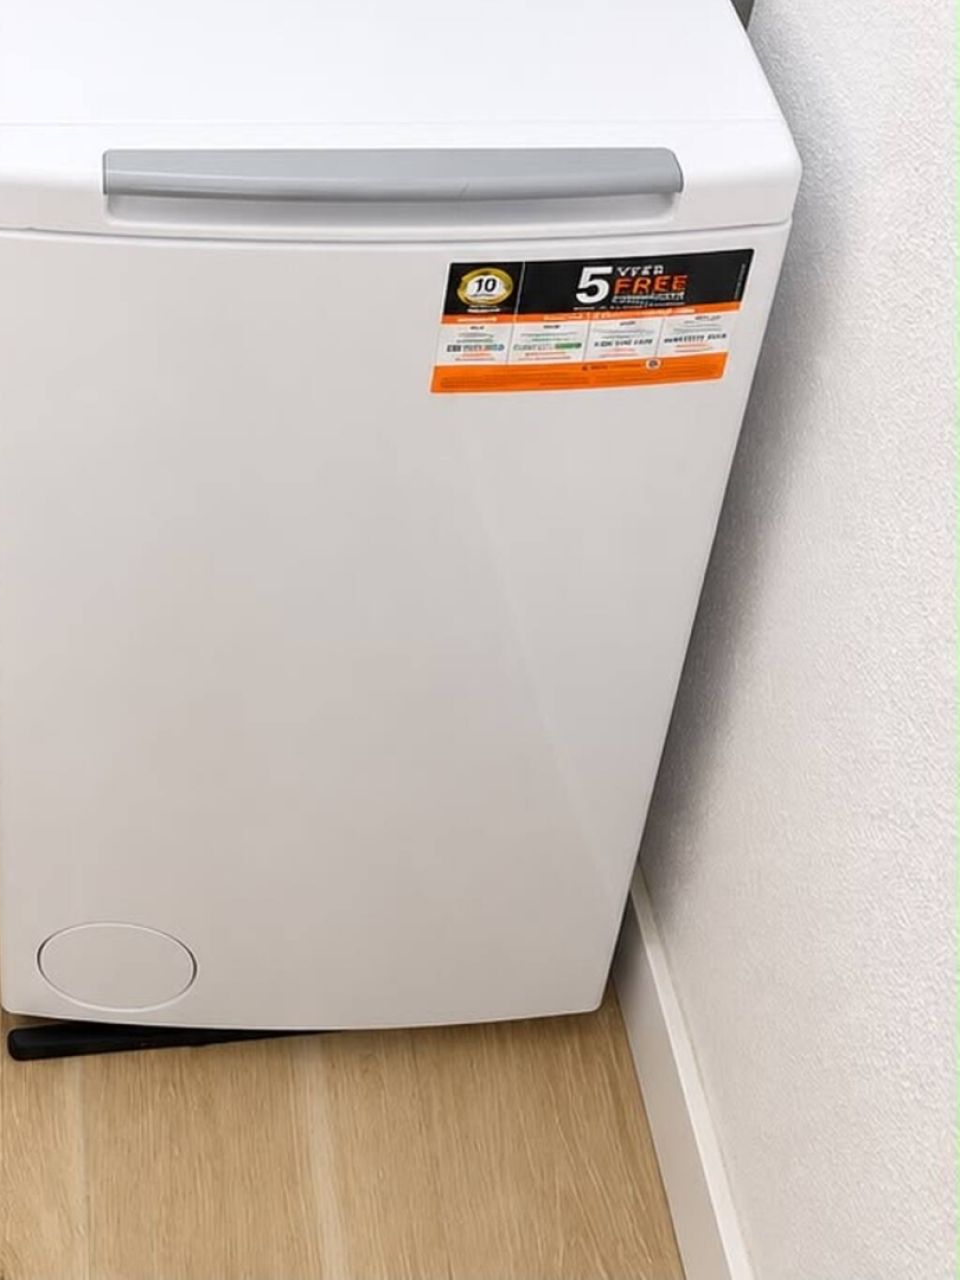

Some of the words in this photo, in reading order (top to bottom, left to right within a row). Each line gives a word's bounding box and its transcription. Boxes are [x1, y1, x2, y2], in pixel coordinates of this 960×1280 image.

[475, 278, 497, 293] 10
[575, 266, 613, 305] 5
[614, 275, 688, 295] FREE
